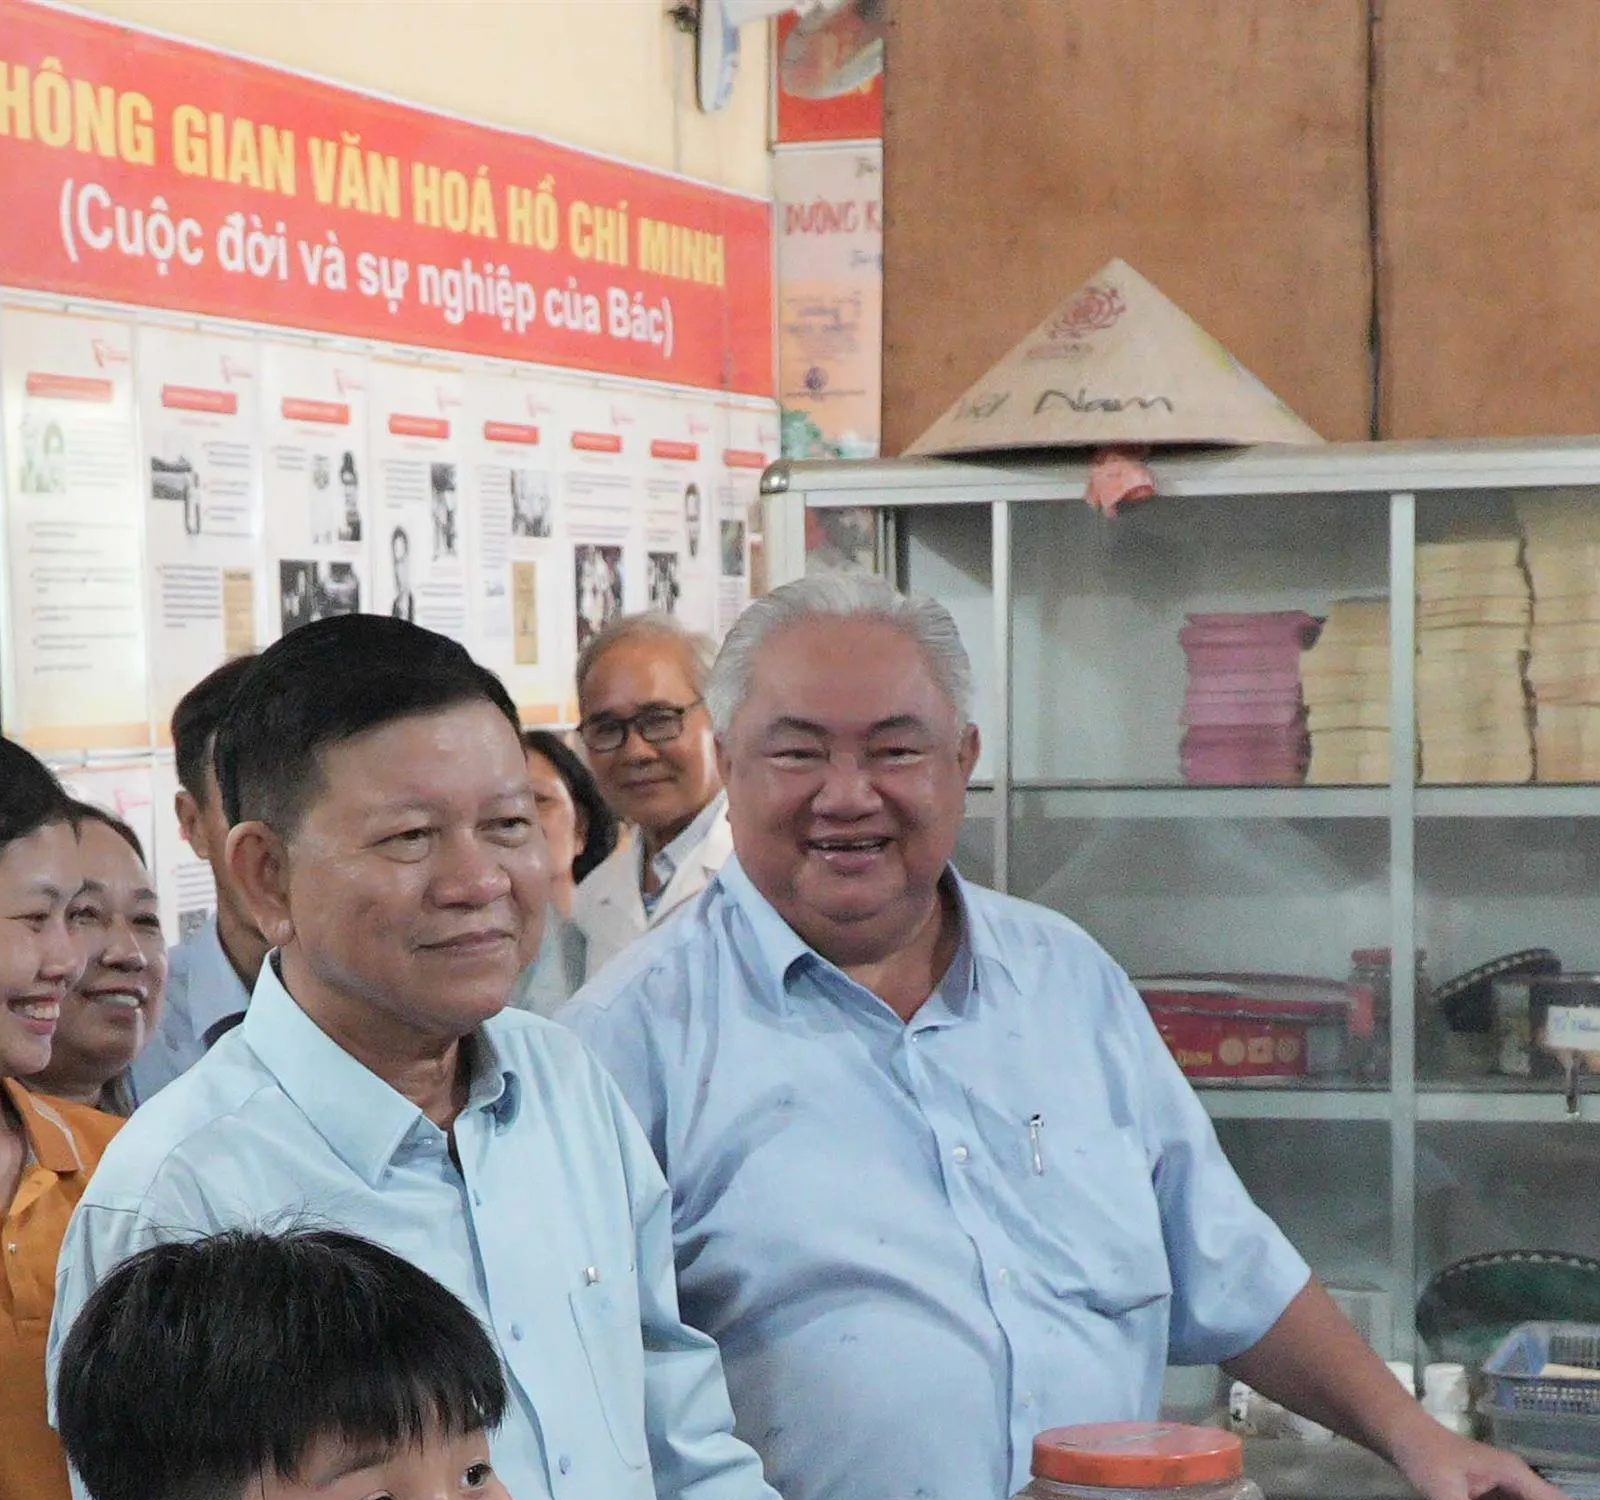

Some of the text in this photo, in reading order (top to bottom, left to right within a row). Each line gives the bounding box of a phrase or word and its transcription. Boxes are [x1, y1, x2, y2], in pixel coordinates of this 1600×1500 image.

[59, 178, 674, 358] (Cuộc đời và sự nghiệp của Bác)
[173, 105, 296, 196] GIAN
[308, 131, 400, 218] VĂN
[411, 165, 497, 239] HOÁ
[508, 175, 559, 252] HỒ
[570, 200, 629, 266] CHÍ
[639, 218, 726, 287] MINH
